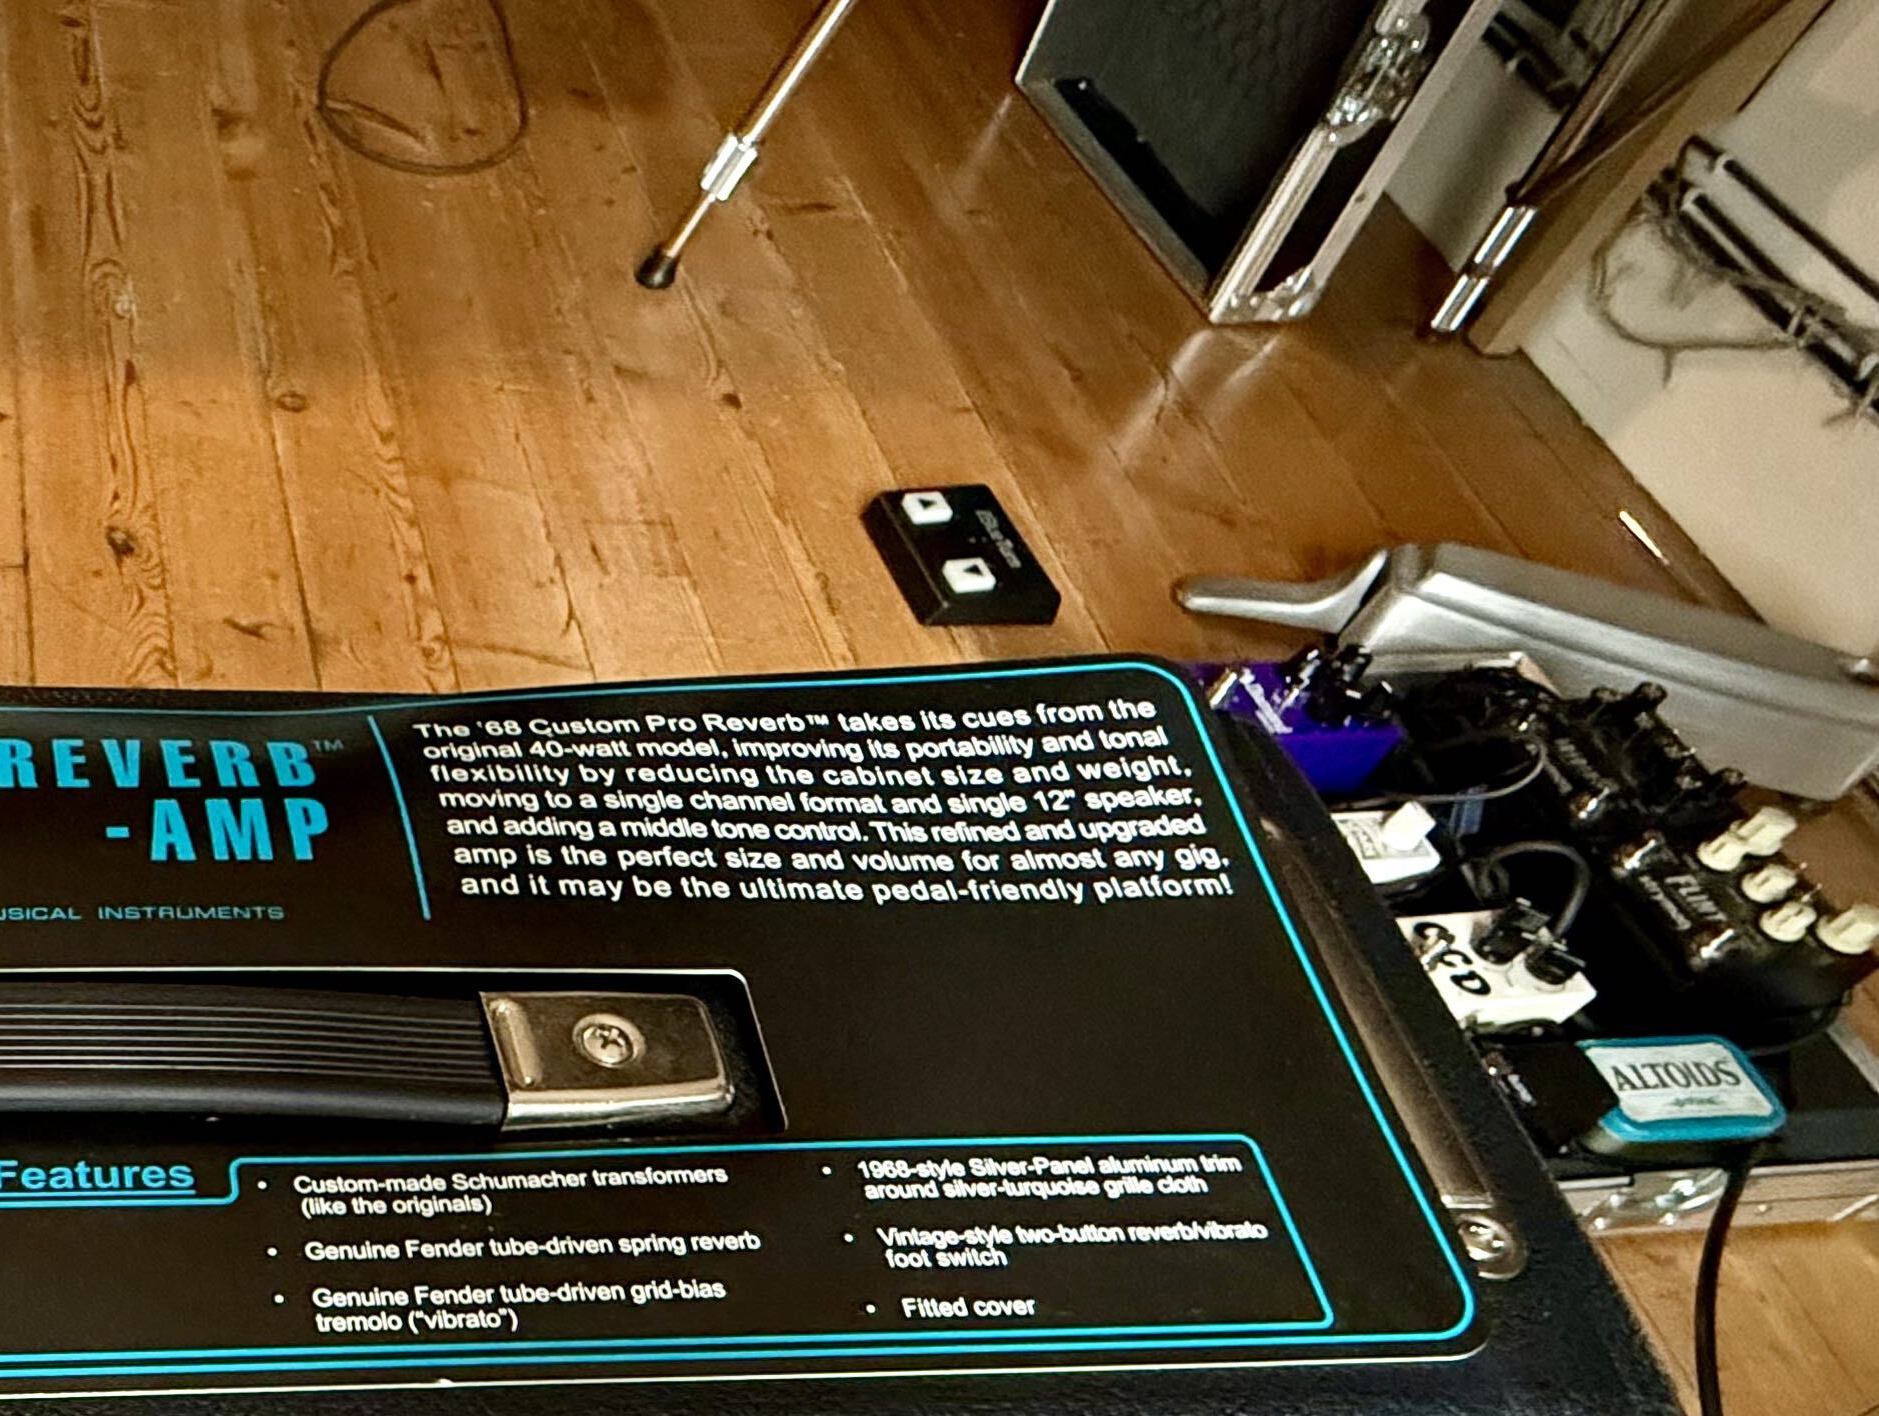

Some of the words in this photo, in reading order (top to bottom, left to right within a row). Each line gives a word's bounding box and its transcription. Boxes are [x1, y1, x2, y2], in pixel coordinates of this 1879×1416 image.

[413, 724, 470, 738] The
[529, 718, 640, 737] Custom
[645, 715, 697, 732] Pro
[837, 712, 916, 732] takes
[919, 710, 956, 730] its
[962, 709, 1032, 729] cues
[1036, 703, 1104, 724] from
[1108, 698, 1157, 720] the
[423, 741, 523, 762] original
[529, 740, 632, 757] 40-watt
[732, 738, 864, 761] improving
[867, 738, 901, 758] its
[905, 734, 1033, 760] portability
[1041, 729, 1095, 753] and
[1098, 725, 1169, 750] tonal
[430, 764, 569, 786] flexibility
[578, 764, 615, 786] by
[625, 763, 759, 788] reducing
[765, 764, 814, 785] the
[823, 765, 935, 786] cabinet
[941, 765, 1004, 786] size
[1012, 760, 1070, 783] and
[461, 874, 519, 895] and
[529, 874, 550, 895] it
[559, 879, 623, 902] may
[632, 875, 672, 897] be
[681, 876, 730, 898] the
[739, 877, 864, 900] ultimate
[871, 878, 1083, 905] pedal-friendly
[1093, 873, 1233, 903] platform!
[98, 906, 285, 920] INSTRUMENTS
[1611, 1059, 1741, 1091] ALTOIDS
[293, 1174, 446, 1194] Custom-made
[452, 1171, 587, 1191] Schumacher
[592, 1167, 728, 1186] transformers
[858, 1159, 966, 1181] 1968-style
[968, 1156, 1095, 1176] Silver-Panel
[1097, 1155, 1199, 1174] aluminum
[1199, 1154, 1243, 1172] trim
[864, 1179, 940, 1199] around
[942, 1176, 1101, 1200] silver-turquoise
[1103, 1176, 1154, 1199] grille
[1157, 1175, 1209, 1194] cloth
[301, 1197, 347, 1219] (like
[351, 1197, 387, 1214] the
[392, 1194, 492, 1217] originals)
[305, 1240, 400, 1261] Genuine
[405, 1239, 484, 1258] Fender
[489, 1236, 614, 1256] tube-driven
[618, 1233, 687, 1256] spring
[690, 1231, 761, 1251] reverb
[877, 1225, 1014, 1248] Vintage-style
[1015, 1224, 1126, 1244] two-button
[312, 1287, 409, 1308] Genuine
[414, 1285, 495, 1305] Fender
[499, 1282, 626, 1303] tube-driven
[630, 1279, 727, 1304] grid-bias
[901, 1297, 969, 1318] Fitted
[973, 1299, 1035, 1316] cover
